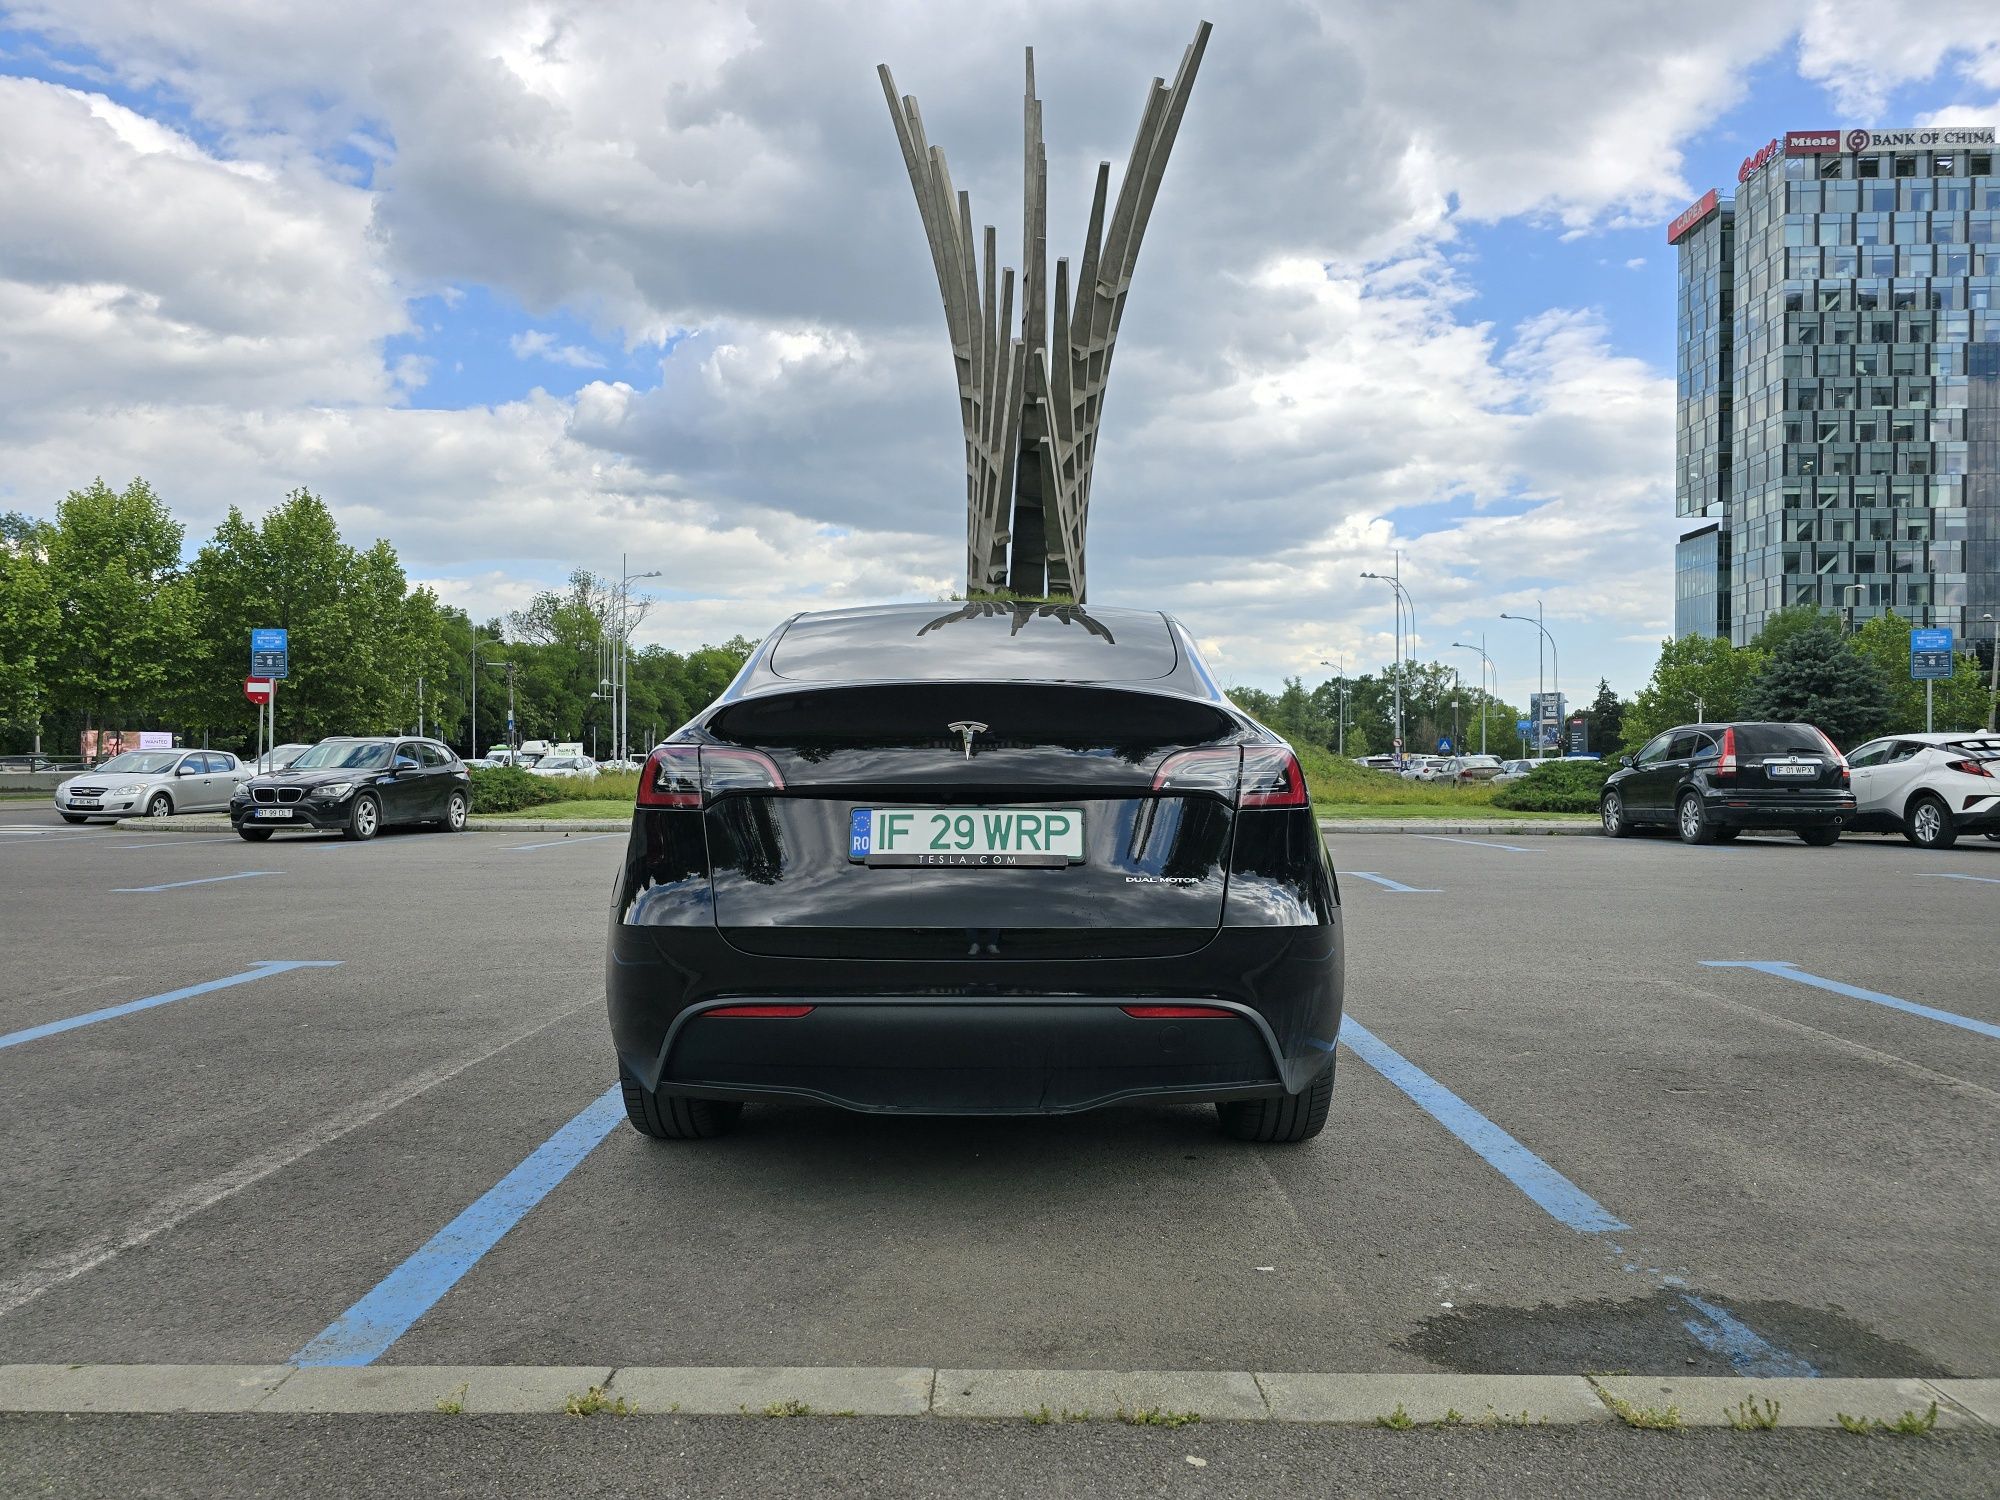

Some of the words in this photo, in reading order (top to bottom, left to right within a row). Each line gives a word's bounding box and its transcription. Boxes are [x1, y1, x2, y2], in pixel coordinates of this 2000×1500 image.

[1790, 137, 1837, 147] Miele
[1872, 133, 1915, 146] BANK
[1920, 133, 1939, 144] OF
[1944, 131, 1995, 144] CHINA
[1676, 199, 1704, 230] CAPEX
[878, 814, 914, 850] IF
[929, 814, 975, 850] 29
[982, 814, 1071, 851] WRP
[853, 836, 869, 850] RO
[918, 855, 1016, 865] TESLA.COM
